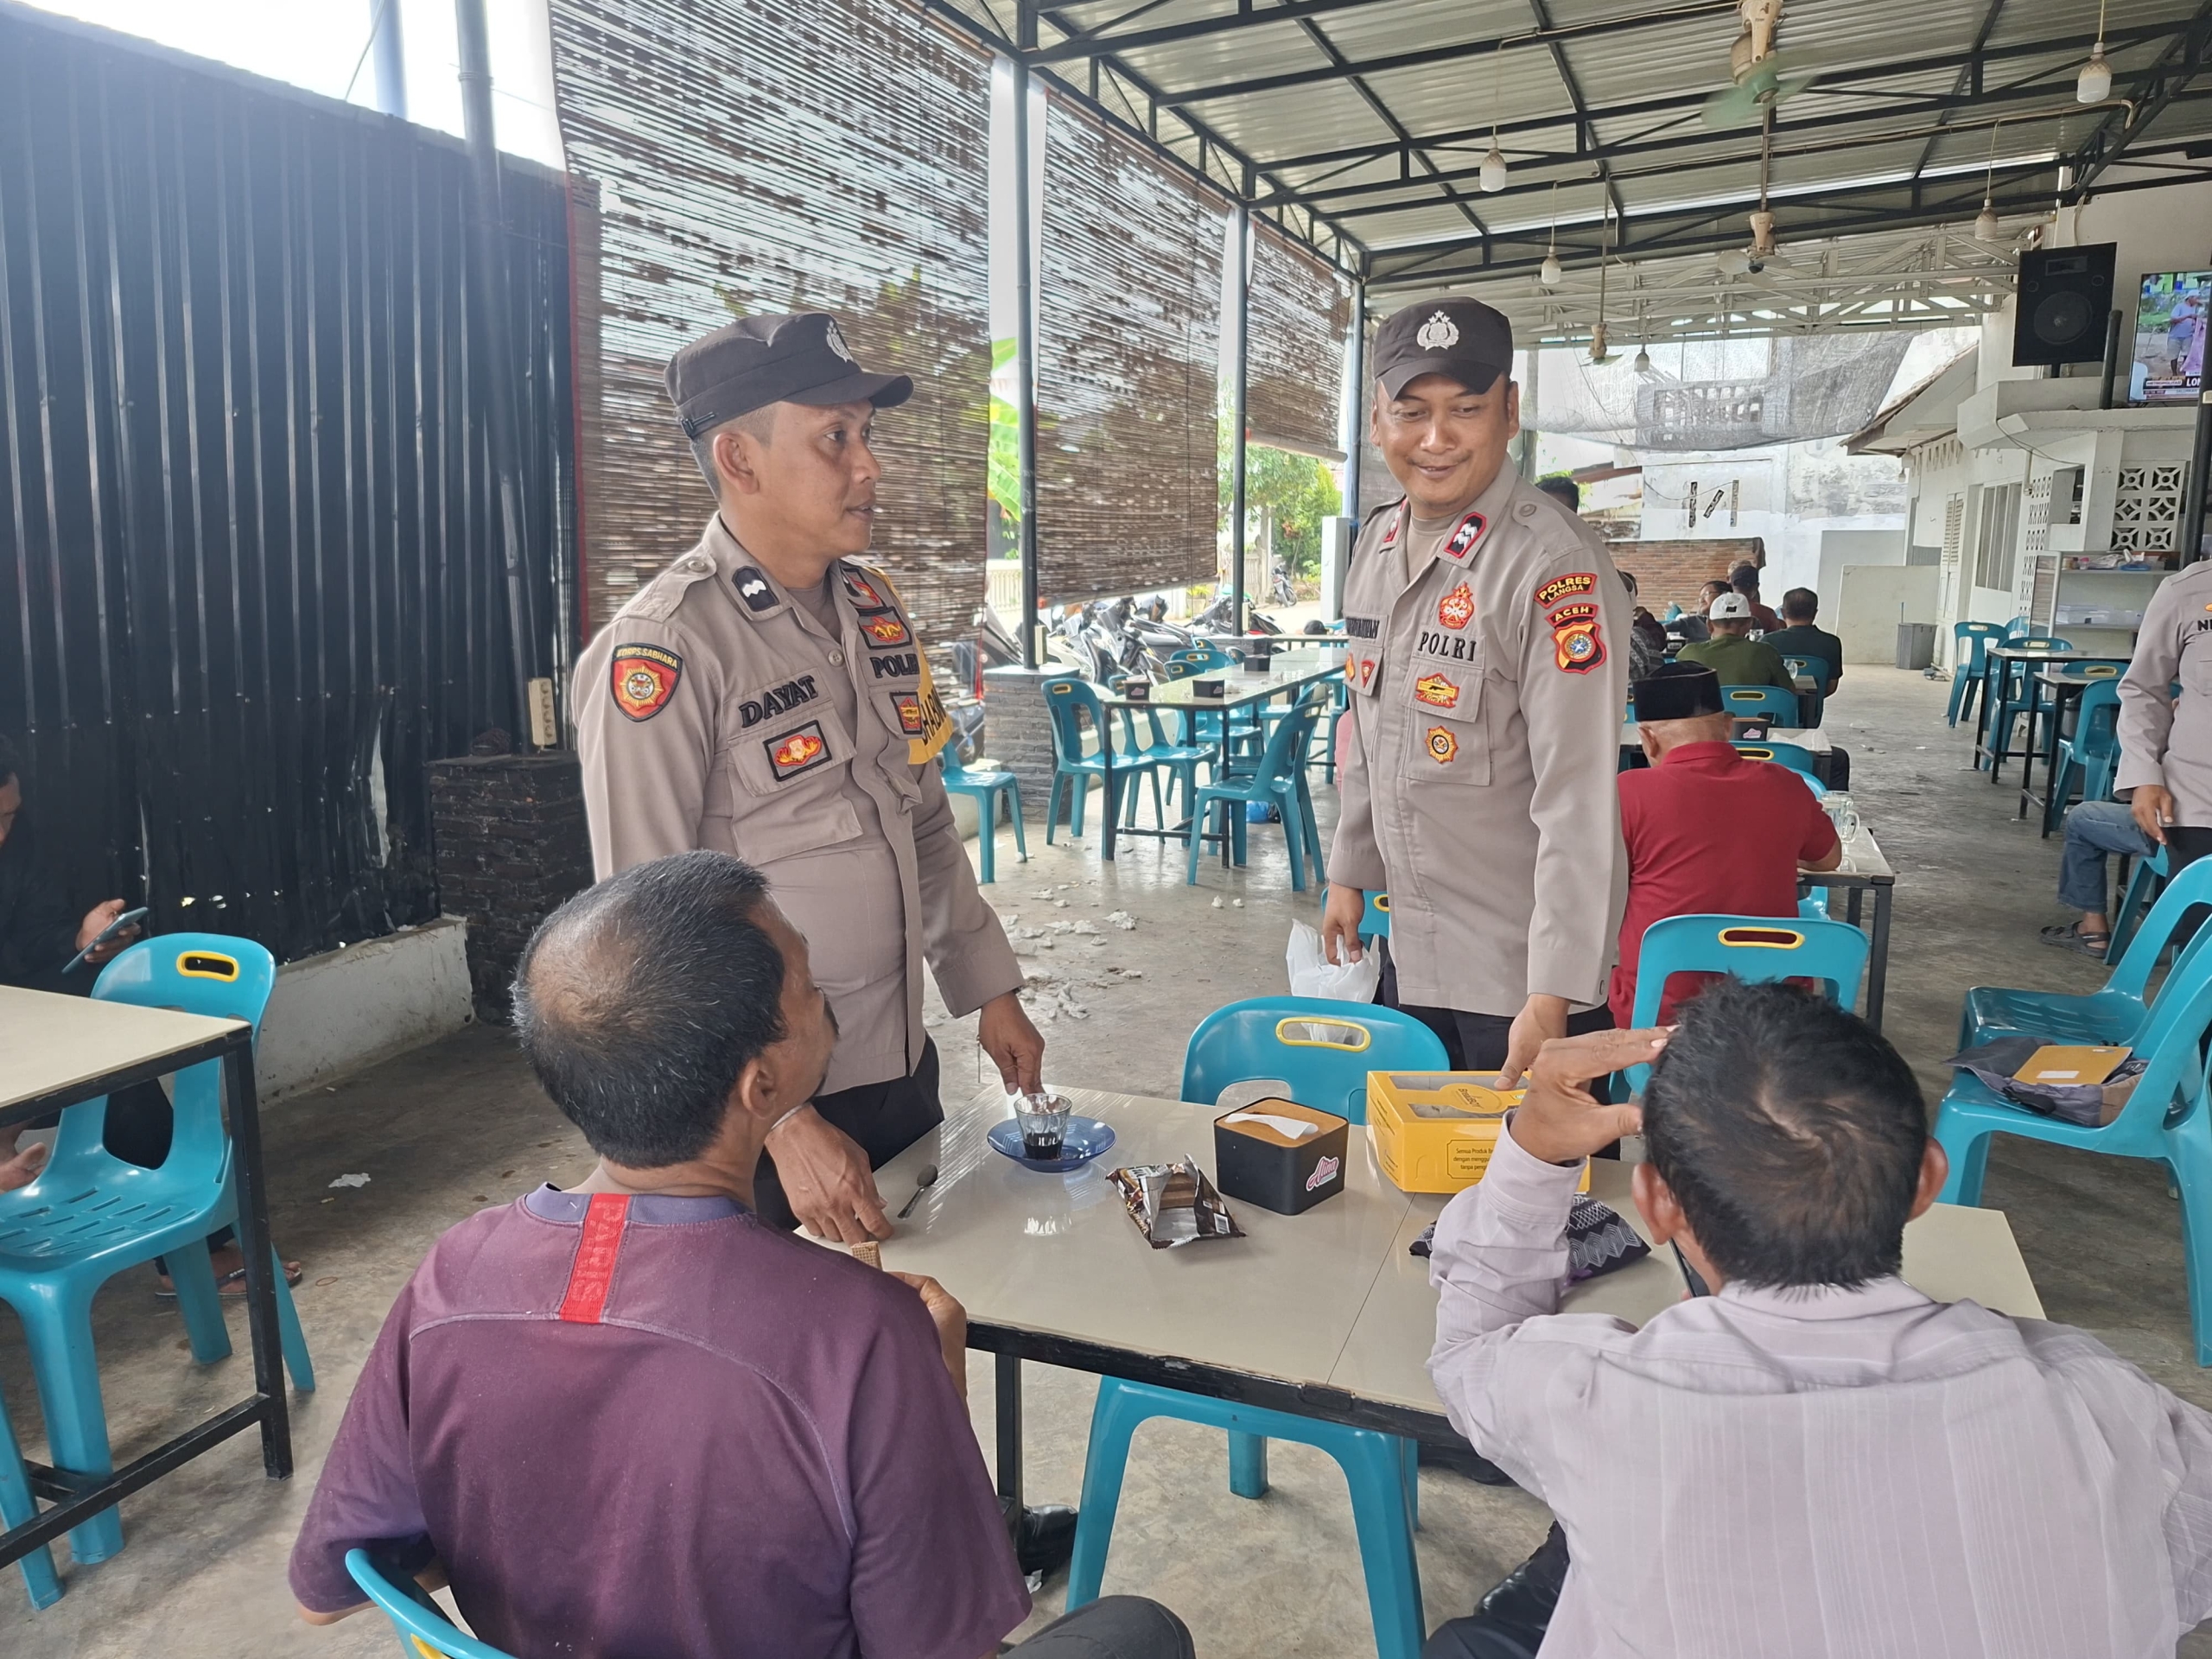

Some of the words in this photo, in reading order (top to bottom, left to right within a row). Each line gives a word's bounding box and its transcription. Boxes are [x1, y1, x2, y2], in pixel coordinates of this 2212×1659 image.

[1539, 576, 1591, 600] POLRES
[1548, 584, 1584, 601] LANGSA
[1555, 607, 1589, 621] ACEH
[616, 646, 641, 658] KORPS
[642, 647, 678, 670] SABHARA
[1418, 632, 1477, 662] POLRI
[739, 675, 818, 728] DAYAT
[570, 1202, 625, 1302] PARIS
